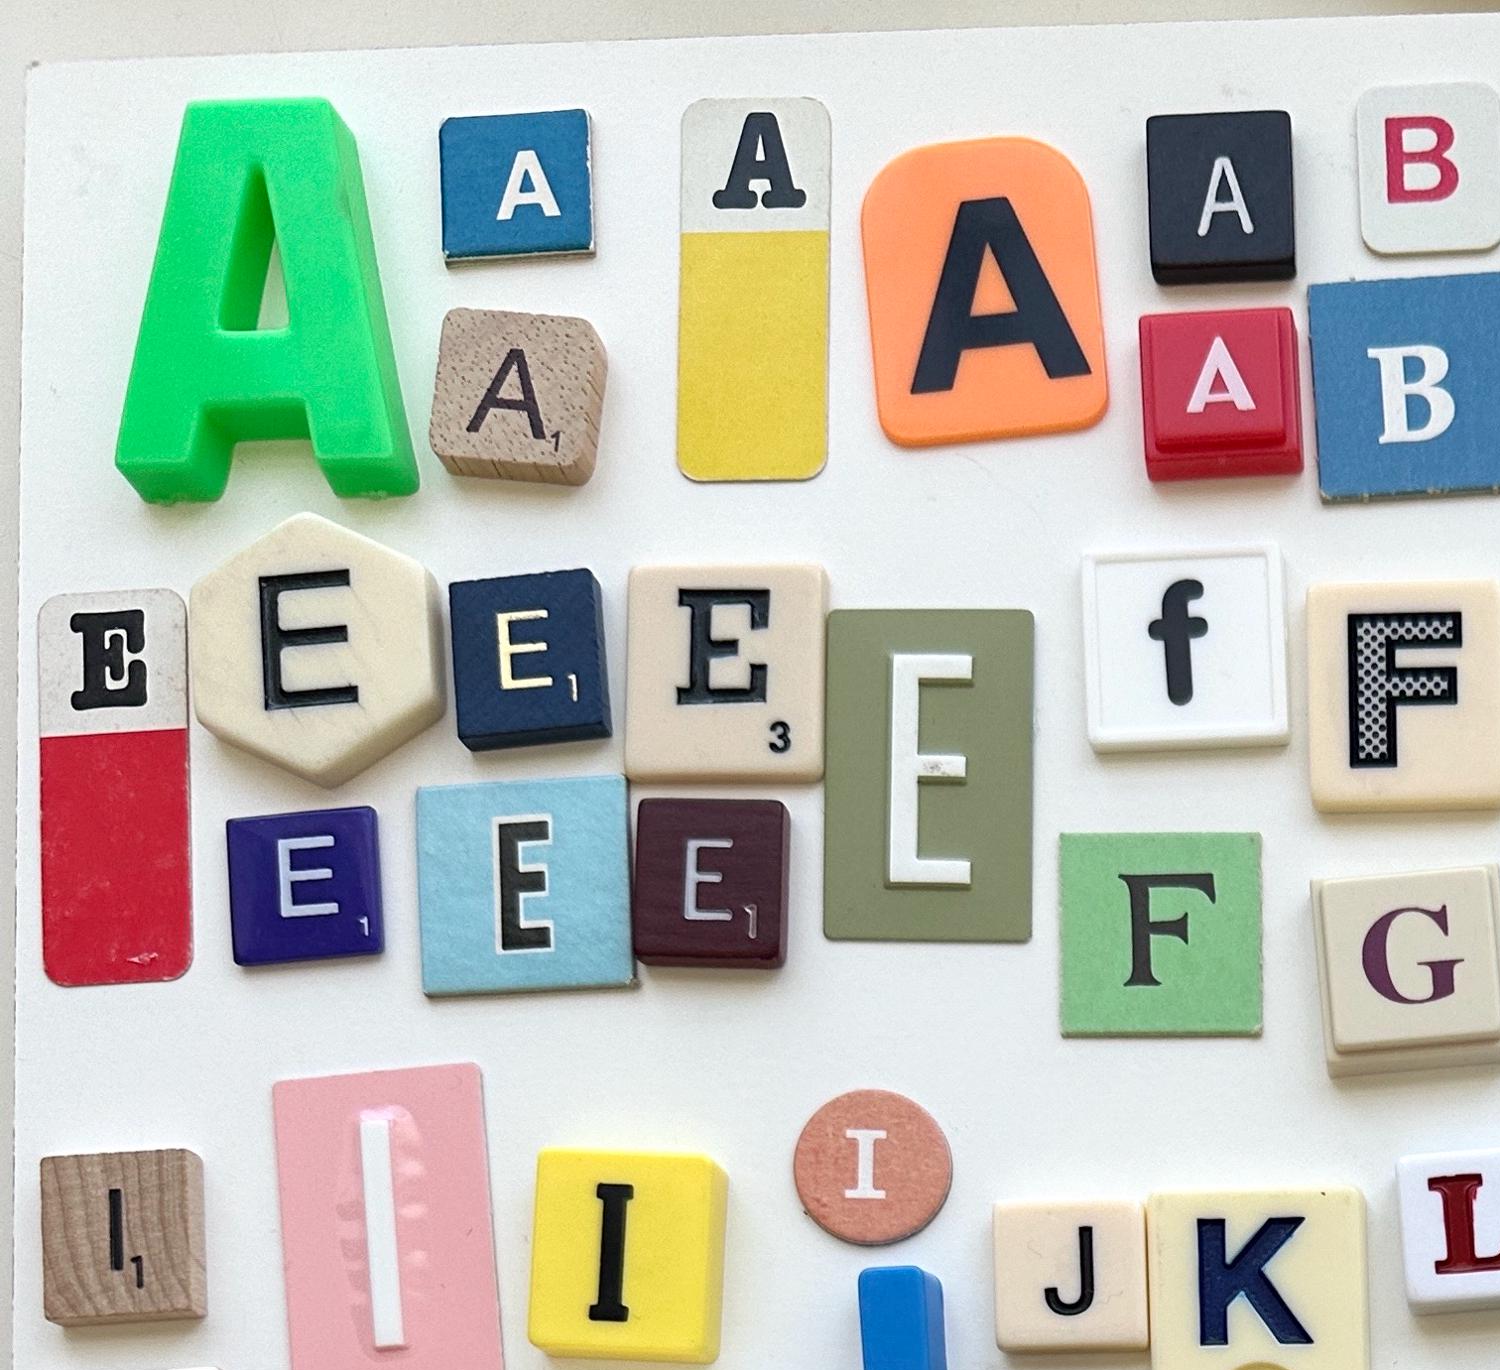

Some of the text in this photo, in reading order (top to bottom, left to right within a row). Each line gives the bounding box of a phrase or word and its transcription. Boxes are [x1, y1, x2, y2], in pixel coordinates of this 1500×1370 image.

[496, 149, 562, 221] A
[712, 112, 807, 210] A
[1197, 156, 1255, 237] A
[1384, 116, 1460, 205] B
[115, 97, 420, 504] A
[910, 196, 1092, 395] A
[465, 347, 546, 442] A
[1186, 335, 1257, 413] A
[1367, 344, 1456, 446] B
[69, 608, 148, 712] E
[258, 568, 360, 711] E
[496, 609, 553, 691] E
[675, 587, 772, 706] E
[1147, 578, 1209, 707] f
[1346, 610, 1463, 769] F
[884, 653, 973, 887] E
[276, 835, 340, 919] E
[491, 812, 556, 956] E
[684, 838, 734, 923] E
[1118, 873, 1217, 988] F
[1360, 904, 1465, 1005] G
[844, 1128, 887, 1200] I
[108, 1188, 124, 1272] I
[359, 1117, 408, 1350] I
[588, 1182, 634, 1322] I
[1044, 1226, 1094, 1316] J
[1195, 1216, 1315, 1346] K
